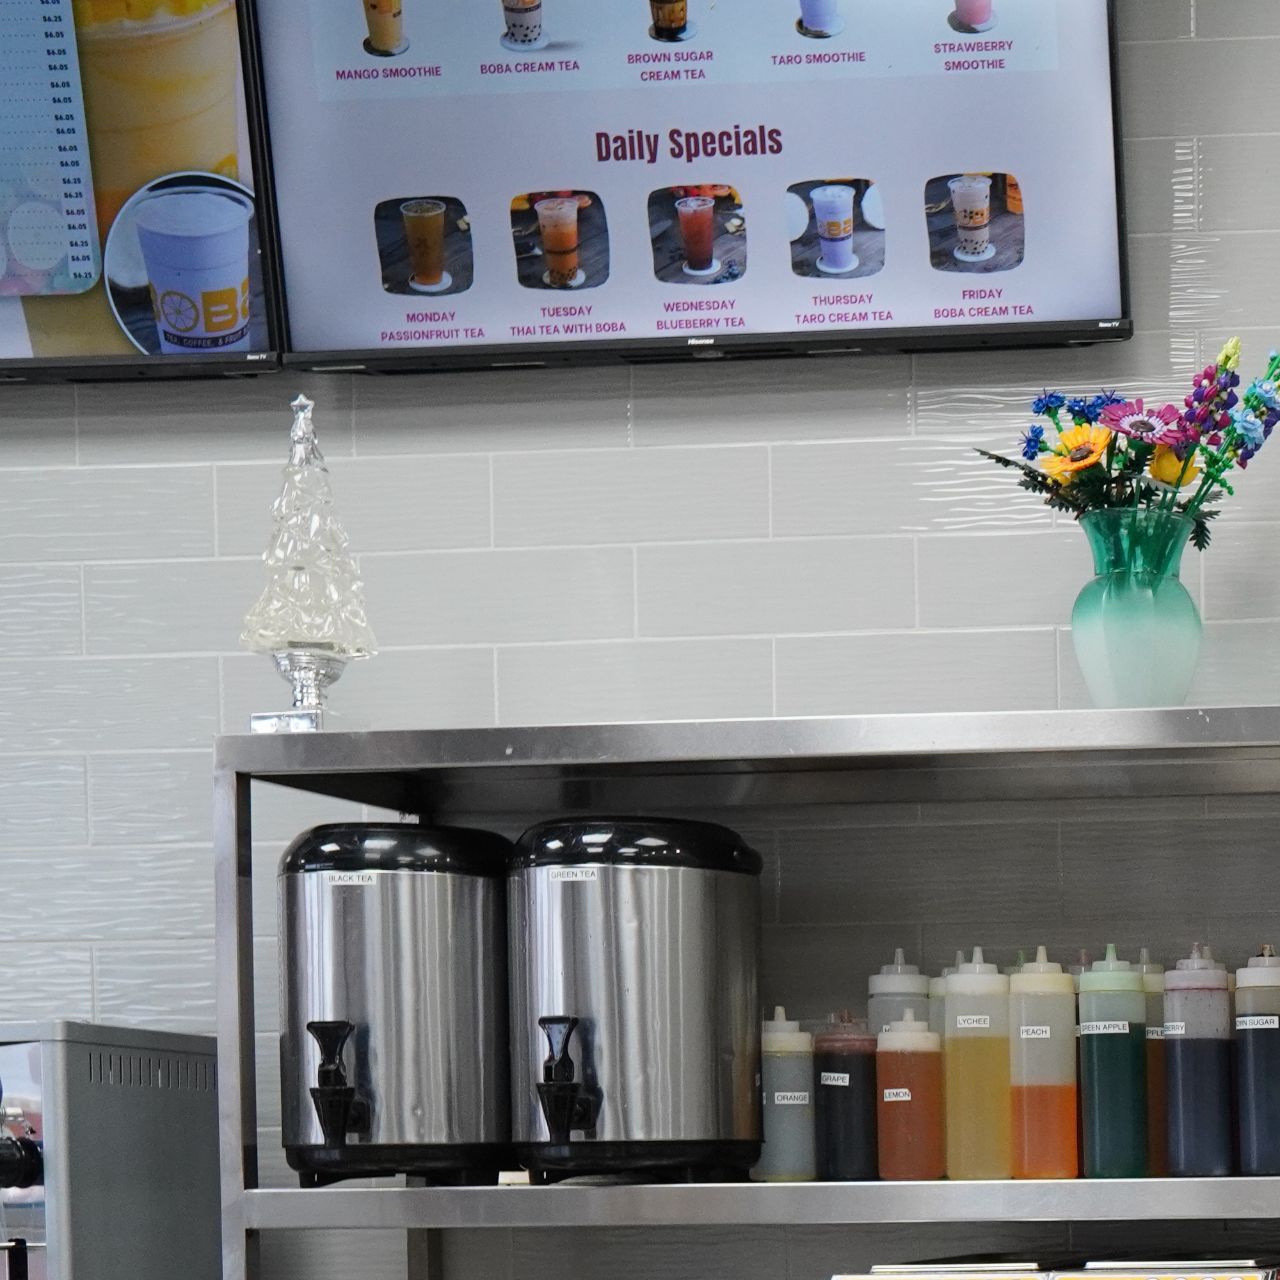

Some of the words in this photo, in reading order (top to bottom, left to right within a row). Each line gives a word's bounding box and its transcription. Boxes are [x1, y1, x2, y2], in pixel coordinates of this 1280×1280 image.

[934, 41, 1013, 54] STRAWBERRY
[627, 52, 671, 65] BROWN
[674, 51, 713, 63] SUGAR
[771, 54, 803, 66] TARO
[805, 52, 866, 65] SMOOTHIE
[480, 63, 512, 75] BOBA
[515, 62, 555, 73] CREAM
[558, 60, 580, 71] TEA
[944, 58, 1006, 72] SMOOTHIE
[335, 69, 380, 81] MANGO
[382, 66, 442, 78] SMOOTHIE
[640, 70, 681, 82] CREAM
[684, 69, 706, 80] TEA
[595, 129, 659, 164] Daily
[668, 124, 783, 163] Specials
[812, 294, 873, 306] THURSDAY
[962, 289, 1003, 300] FRIDAY
[540, 306, 593, 317] TUESDAY
[663, 300, 736, 313] WEDNESDAY
[934, 308, 965, 319] BOBA
[968, 306, 1009, 317] CREAM
[1012, 305, 1034, 315] TEA
[406, 312, 456, 323] MONDAY
[656, 318, 721, 330] BLUEBERRY
[724, 317, 746, 328] TEA
[795, 314, 825, 325] TARO
[829, 312, 869, 323] CREAM
[872, 311, 893, 321] TEA
[381, 328, 460, 342] PASSIONFRUIT
[463, 328, 485, 339] TEA
[510, 325, 536, 336] THAI
[539, 325, 560, 335] TEA
[562, 324, 593, 334] WITH
[595, 322, 626, 333] BOBA
[328, 875, 354, 883] BLACK
[356, 874, 373, 883] TEA
[551, 870, 578, 879] GREEN
[580, 870, 596, 879] TEA
[958, 1017, 989, 1026] LYCHEE
[1102, 1023, 1128, 1031] APPLE
[1249, 1017, 1275, 1026] SUGAR
[1021, 1028, 1048, 1036] PEACH
[821, 1074, 847, 1084] GRAPE
[776, 1094, 808, 1102] ORANGE
[884, 1091, 910, 1099] LEMON
